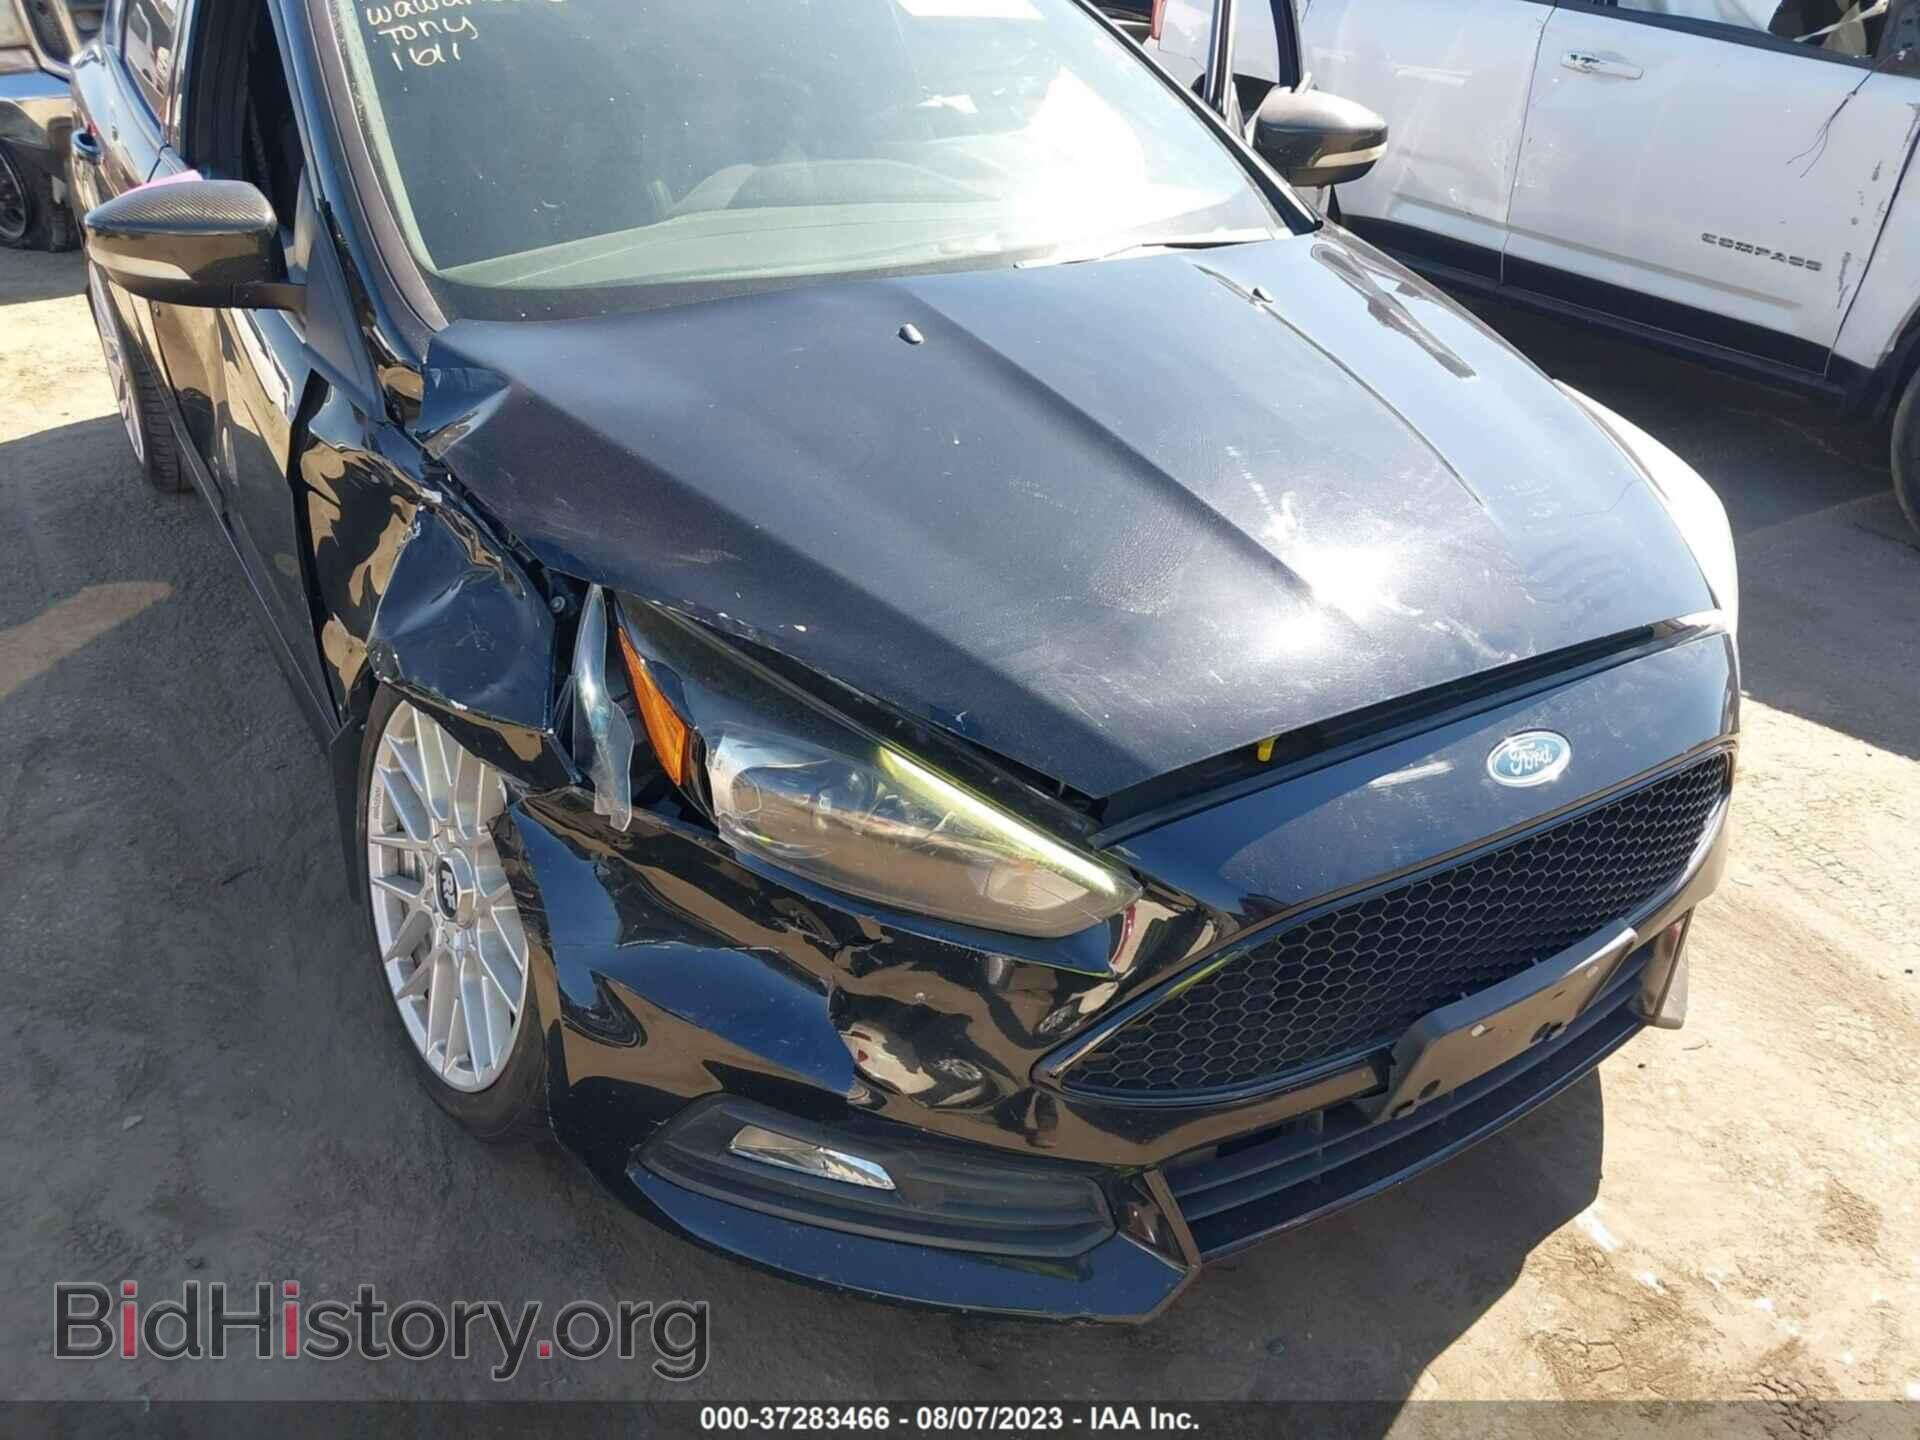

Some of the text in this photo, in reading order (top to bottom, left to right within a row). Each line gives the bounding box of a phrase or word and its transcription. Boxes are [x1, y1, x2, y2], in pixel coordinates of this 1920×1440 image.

[378, 16, 479, 45] Tony
[1701, 232, 1823, 272] COMPASS
[1507, 741, 1553, 775] Ford
